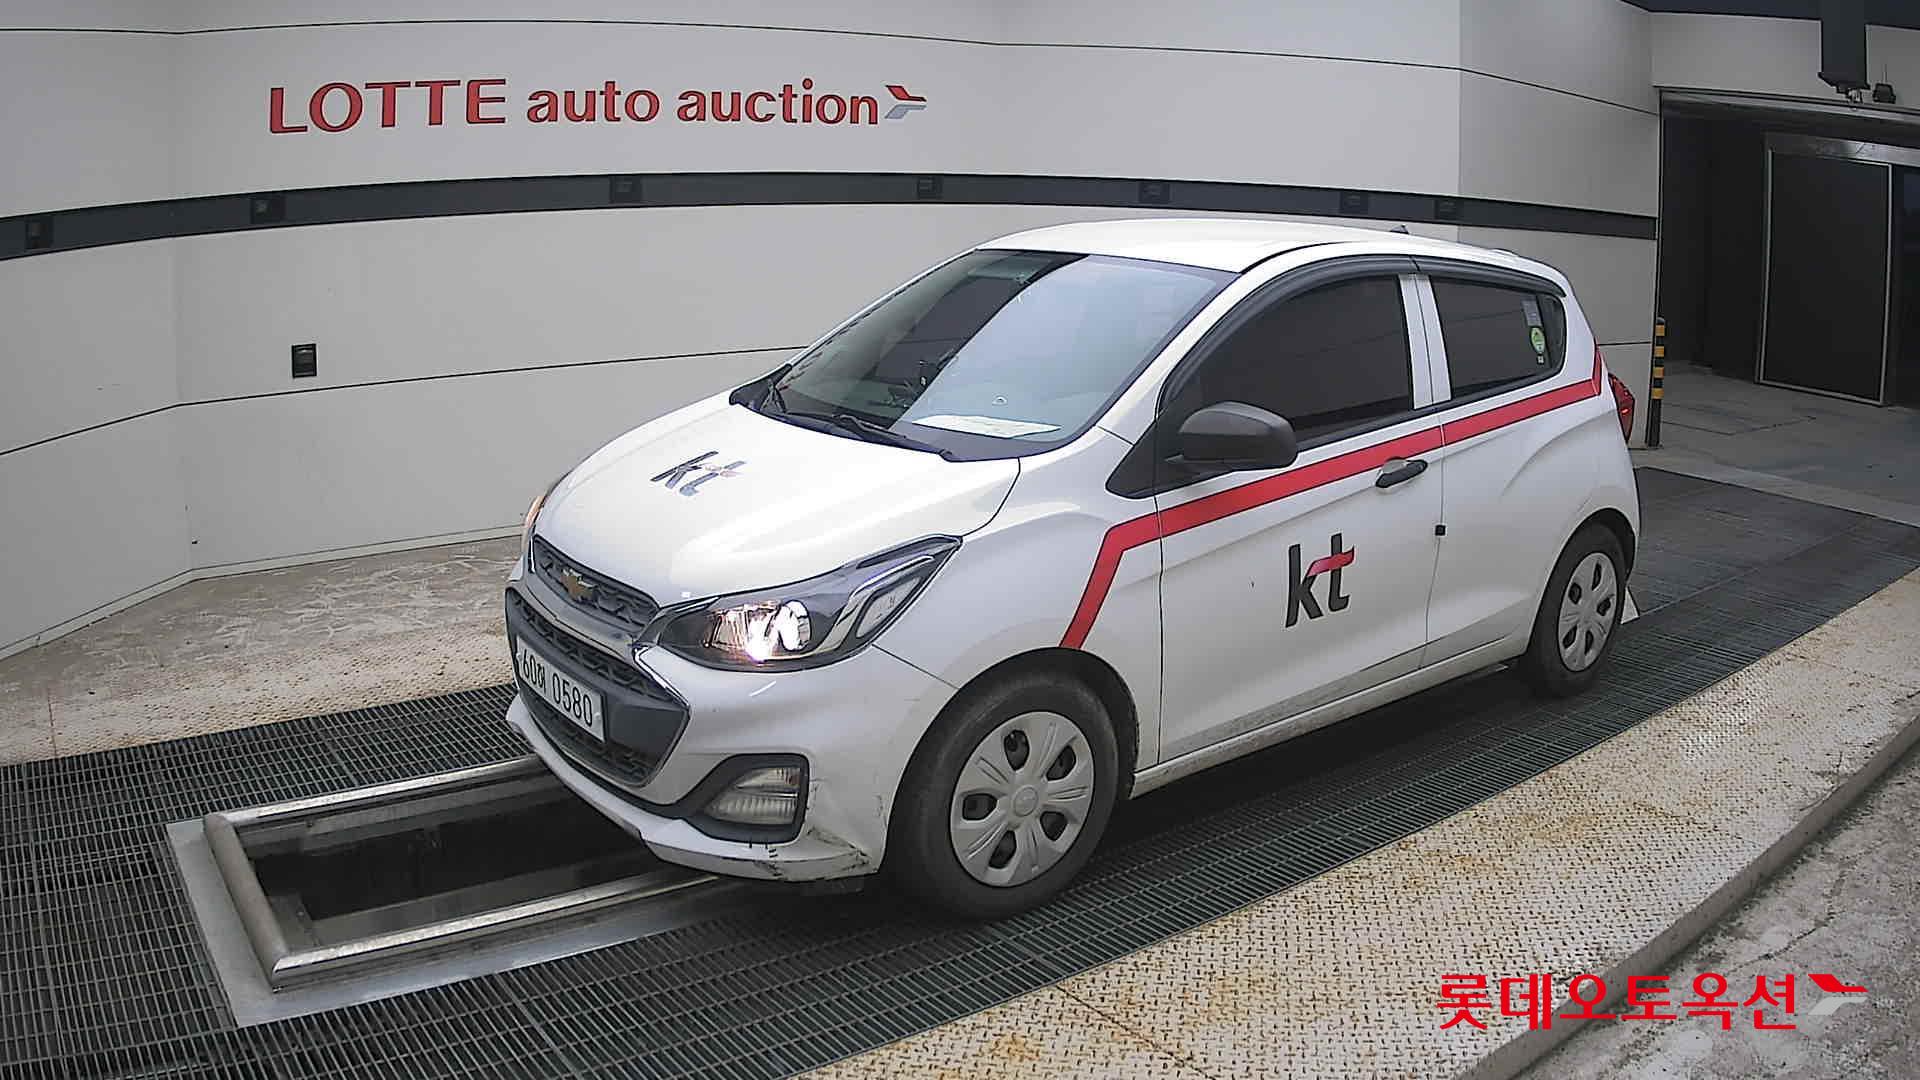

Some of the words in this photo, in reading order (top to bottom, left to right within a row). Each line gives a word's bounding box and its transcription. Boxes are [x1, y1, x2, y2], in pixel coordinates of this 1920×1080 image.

[269, 78, 505, 133] LOTTE
[527, 80, 661, 123] auto
[677, 78, 878, 125] auction
[650, 450, 746, 497] kt
[1285, 532, 1355, 628] kt
[552, 672, 593, 727] 0580
